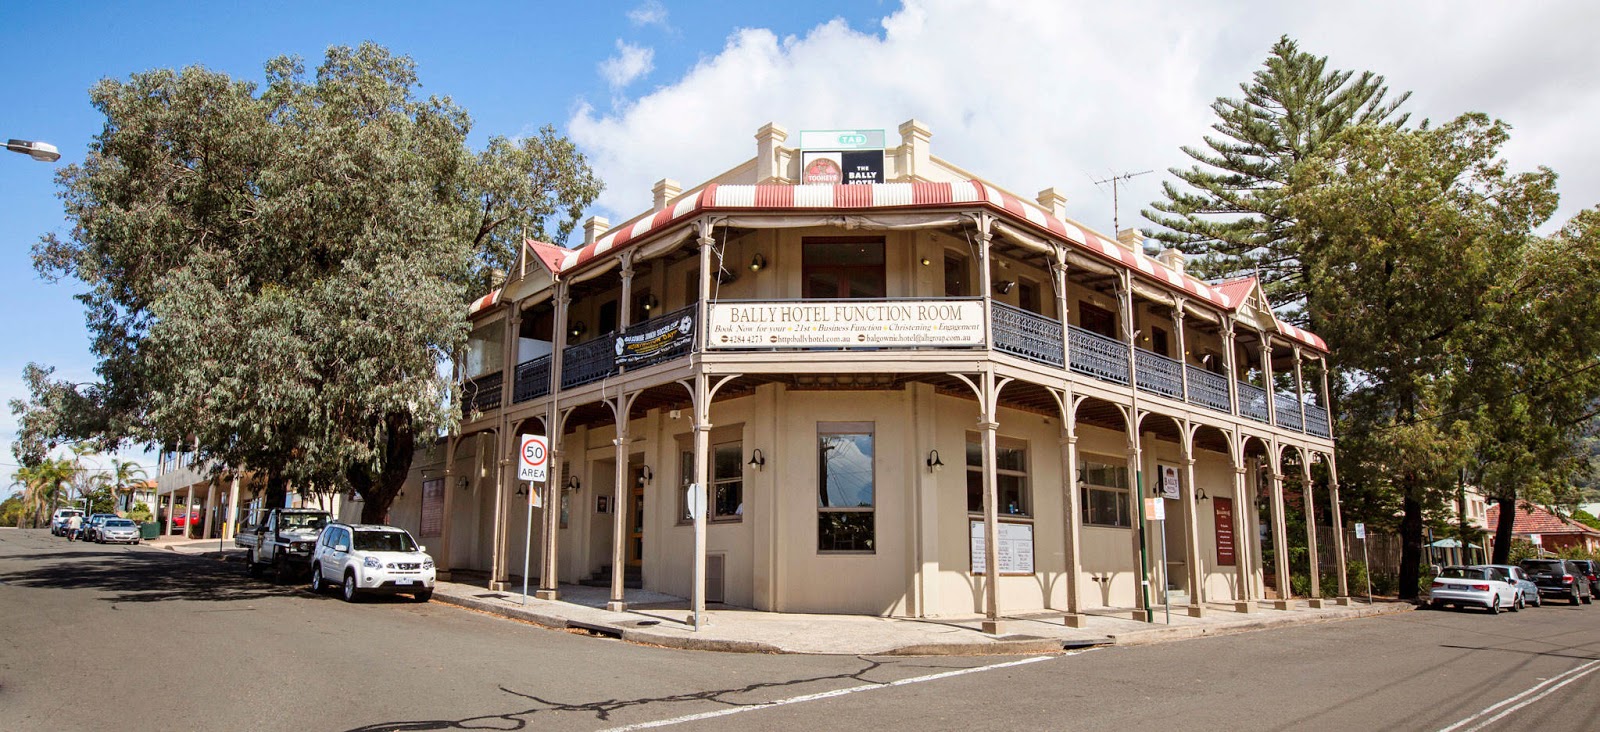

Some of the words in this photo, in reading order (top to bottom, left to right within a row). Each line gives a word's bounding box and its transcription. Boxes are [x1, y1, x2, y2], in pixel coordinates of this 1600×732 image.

[730, 307, 777, 323] BALLY
[780, 306, 829, 322] HOTEL
[834, 305, 912, 322] FUNCTION
[918, 305, 962, 321] ROOM
[715, 324, 733, 333] Book
[736, 324, 753, 333] Now
[756, 324, 767, 333] for
[769, 325, 786, 333] your
[794, 324, 810, 332] 21st
[818, 323, 849, 332] Business
[850, 323, 882, 332] Function
[888, 322, 932, 332] Christening
[938, 322, 980, 332] Engagement
[729, 335, 745, 344] 4284
[526, 446, 543, 459] 50
[521, 468, 545, 478] AREA
